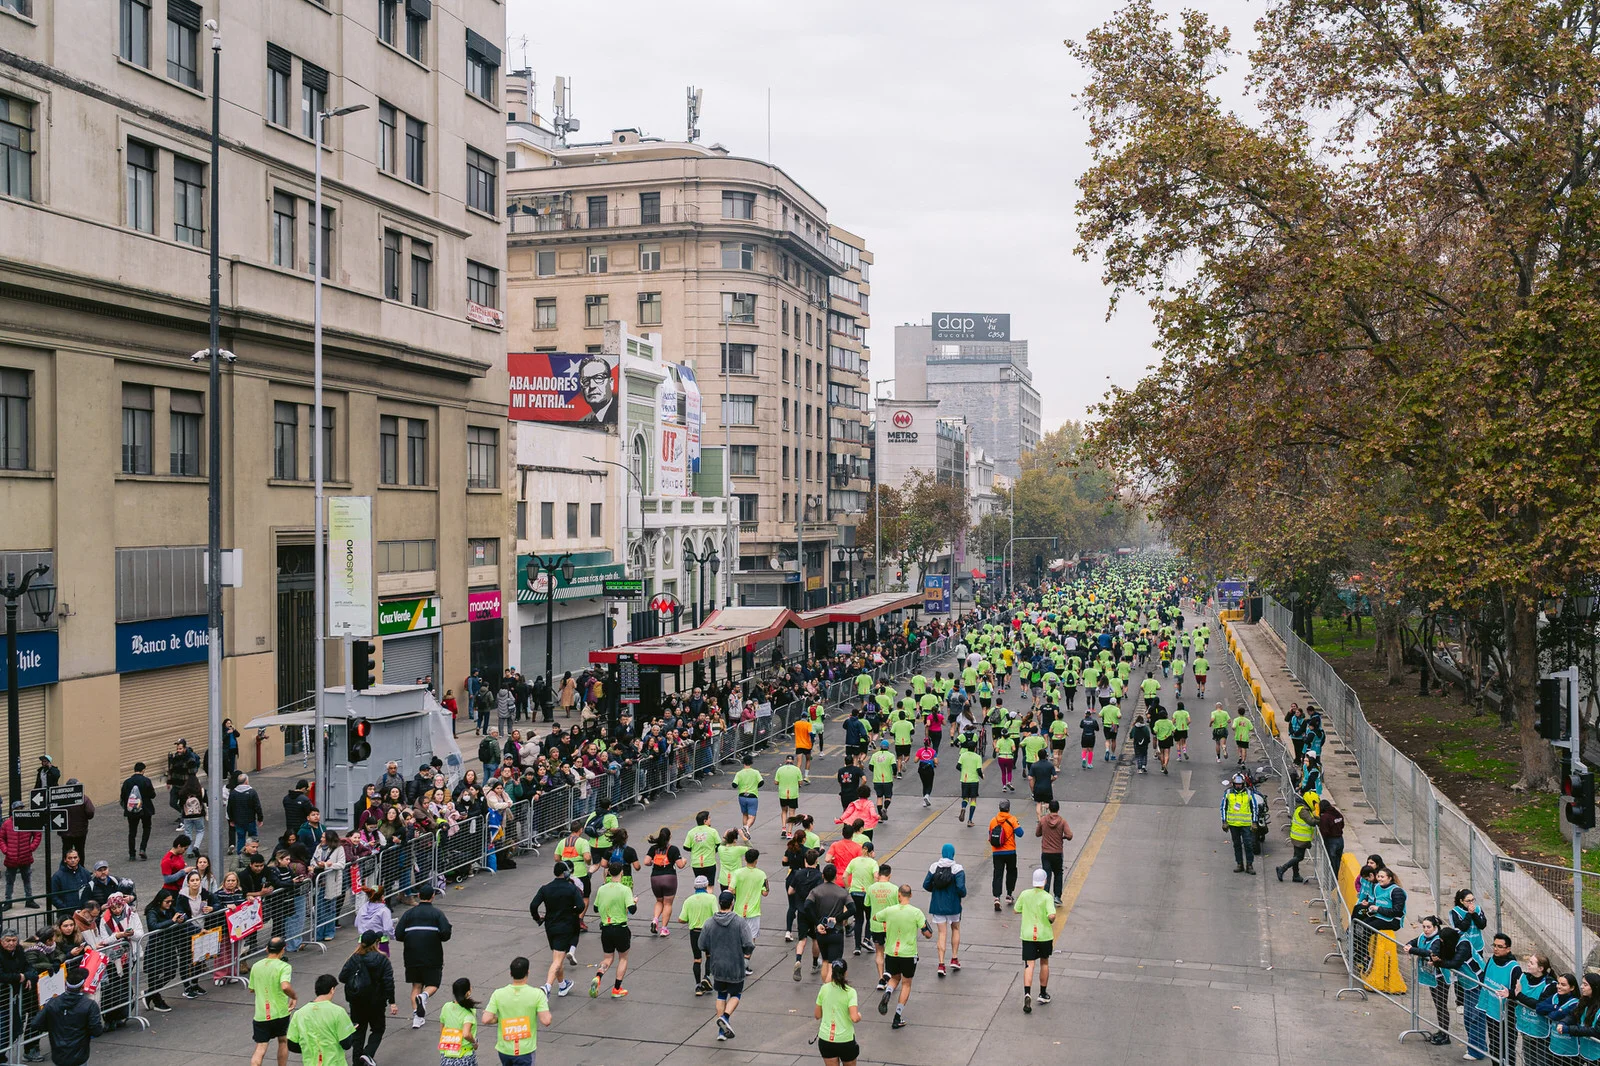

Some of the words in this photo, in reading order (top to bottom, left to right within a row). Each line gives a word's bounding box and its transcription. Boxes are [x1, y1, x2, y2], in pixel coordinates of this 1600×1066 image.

[938, 314, 974, 333] dap
[983, 315, 998, 323] Vive
[509, 376, 578, 391] ABAJADORES
[512, 393, 526, 408] MI
[528, 394, 575, 409] PATRIA...
[380, 611, 393, 624] Cruz
[393, 609, 411, 622] Verde
[131, 634, 167, 655] Banco
[170, 634, 181, 649] de
[184, 629, 209, 649] Chile
